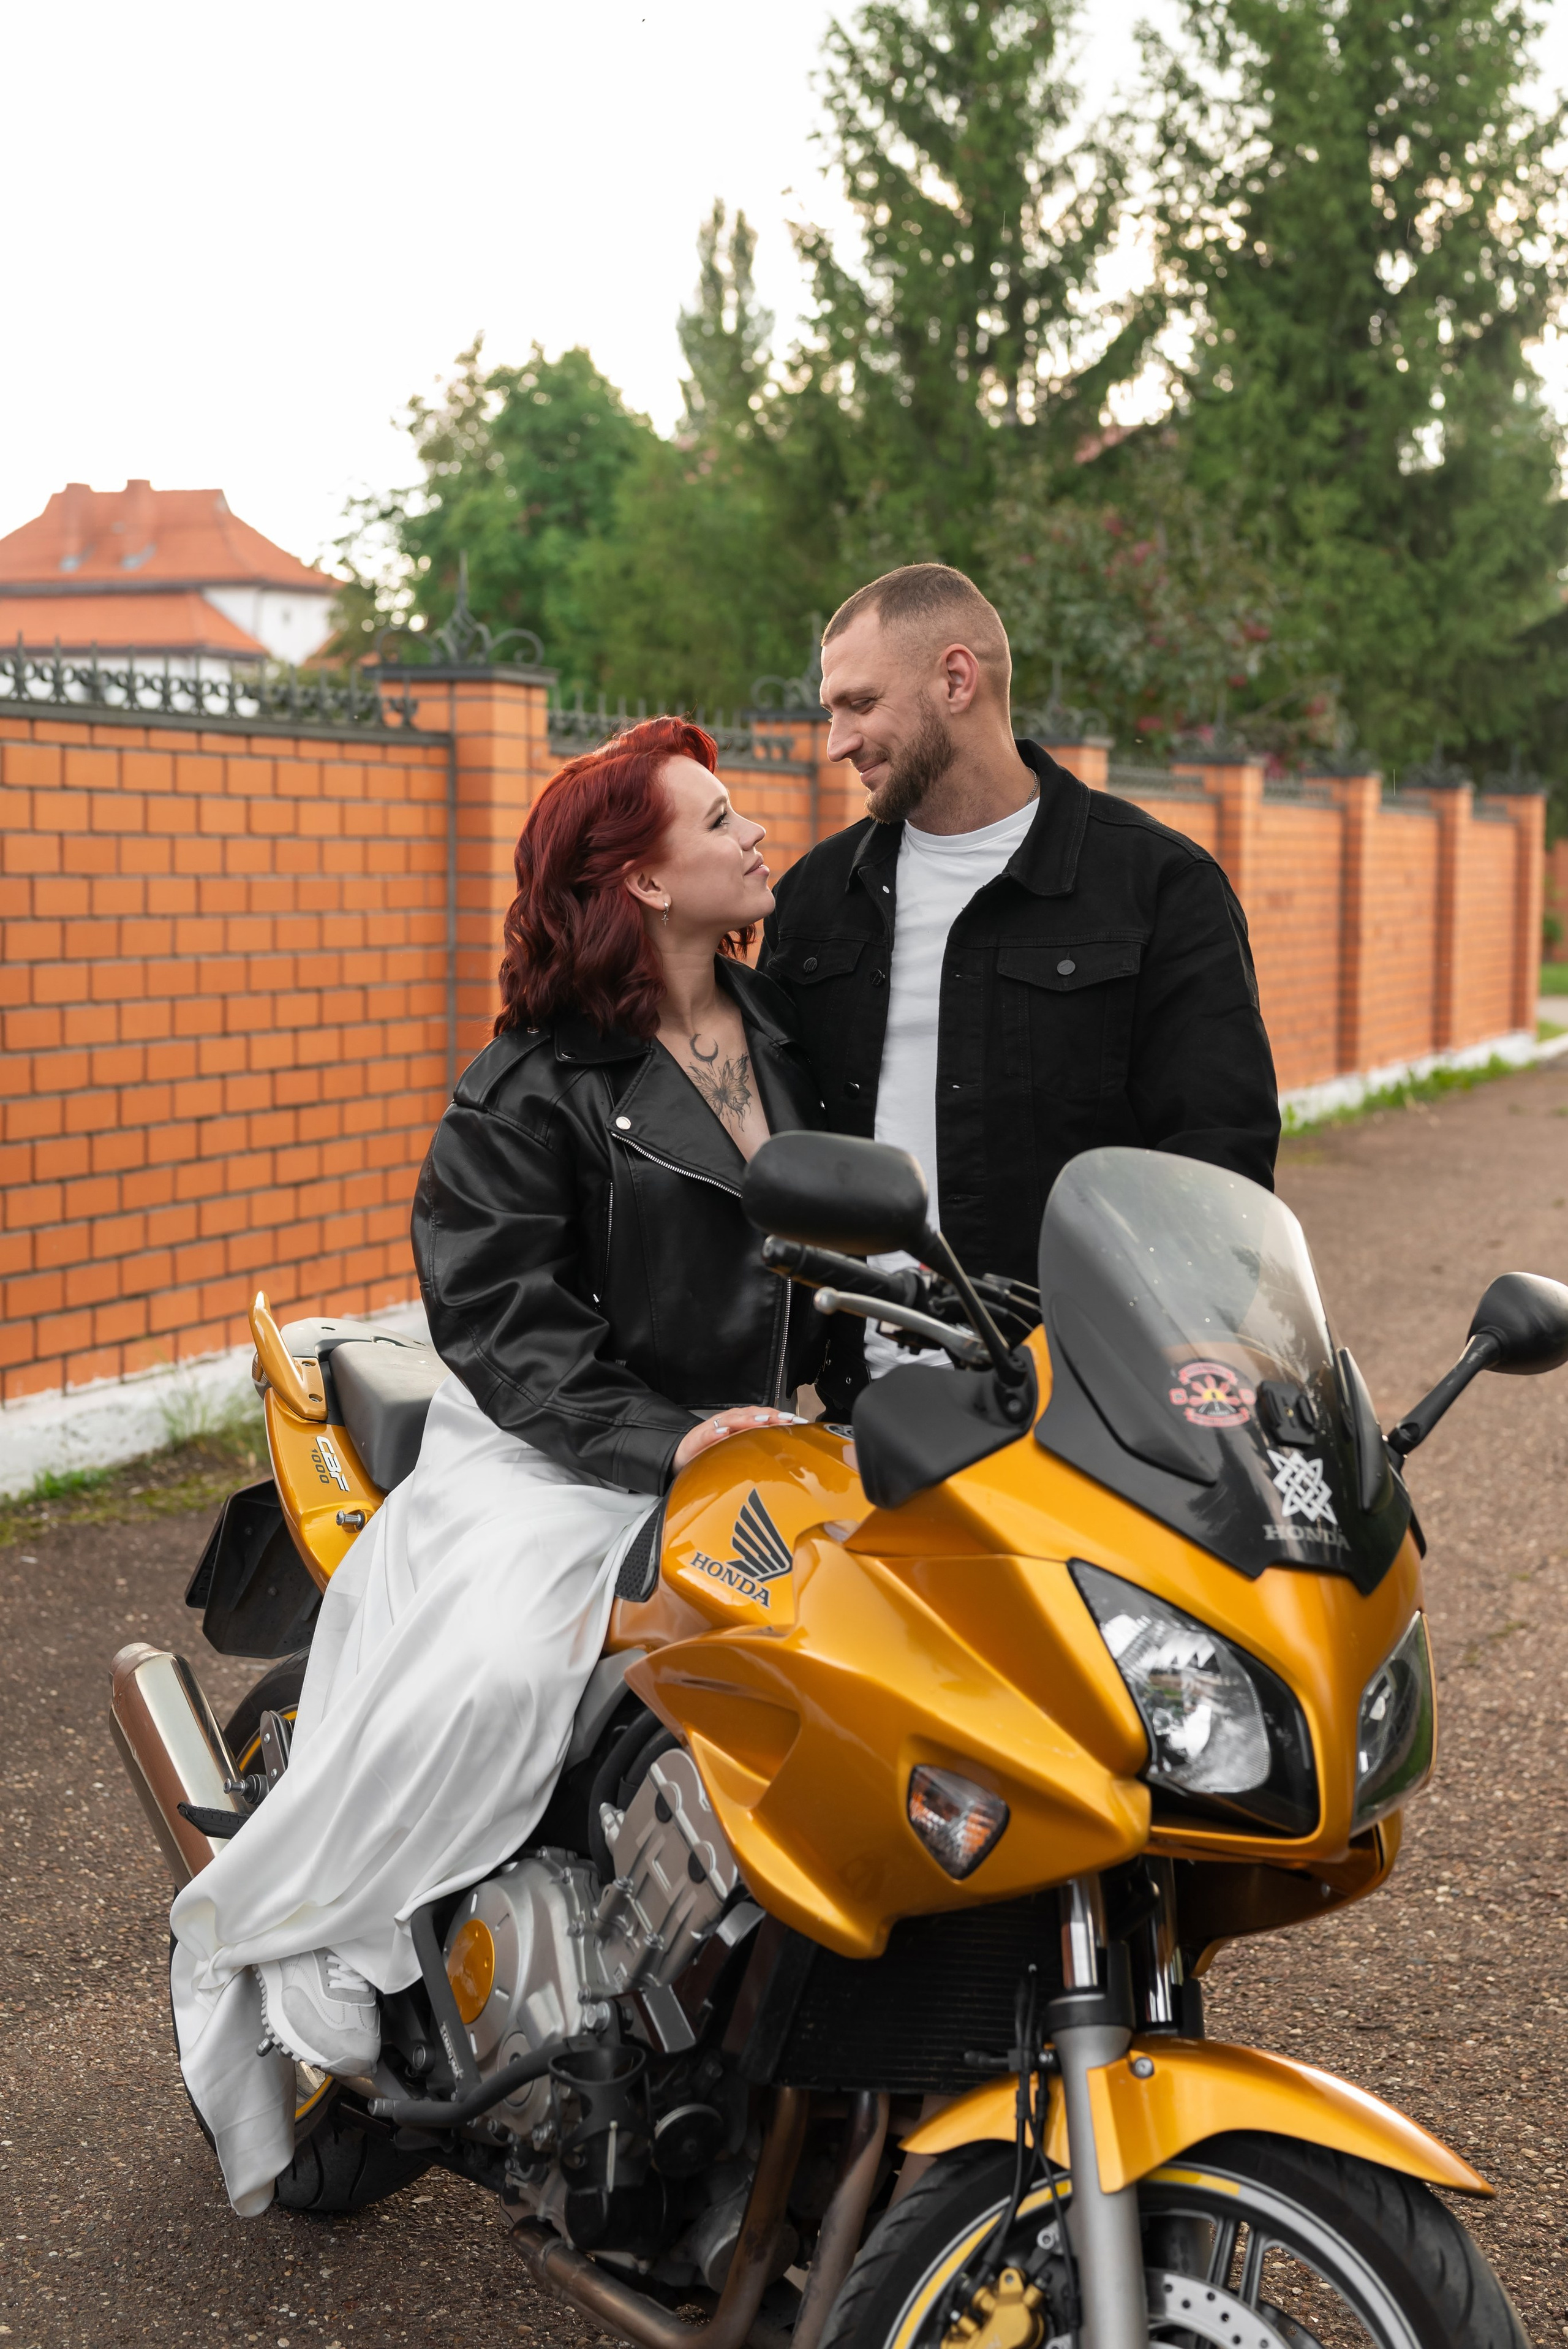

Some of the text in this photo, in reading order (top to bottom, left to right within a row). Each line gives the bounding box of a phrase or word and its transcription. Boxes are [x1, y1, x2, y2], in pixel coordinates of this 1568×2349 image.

[311, 1448, 330, 1485] 1000
[315, 1436, 350, 1492] CBF
[1262, 1524, 1352, 1551] HONDA
[690, 1551, 771, 1609] HONDA
